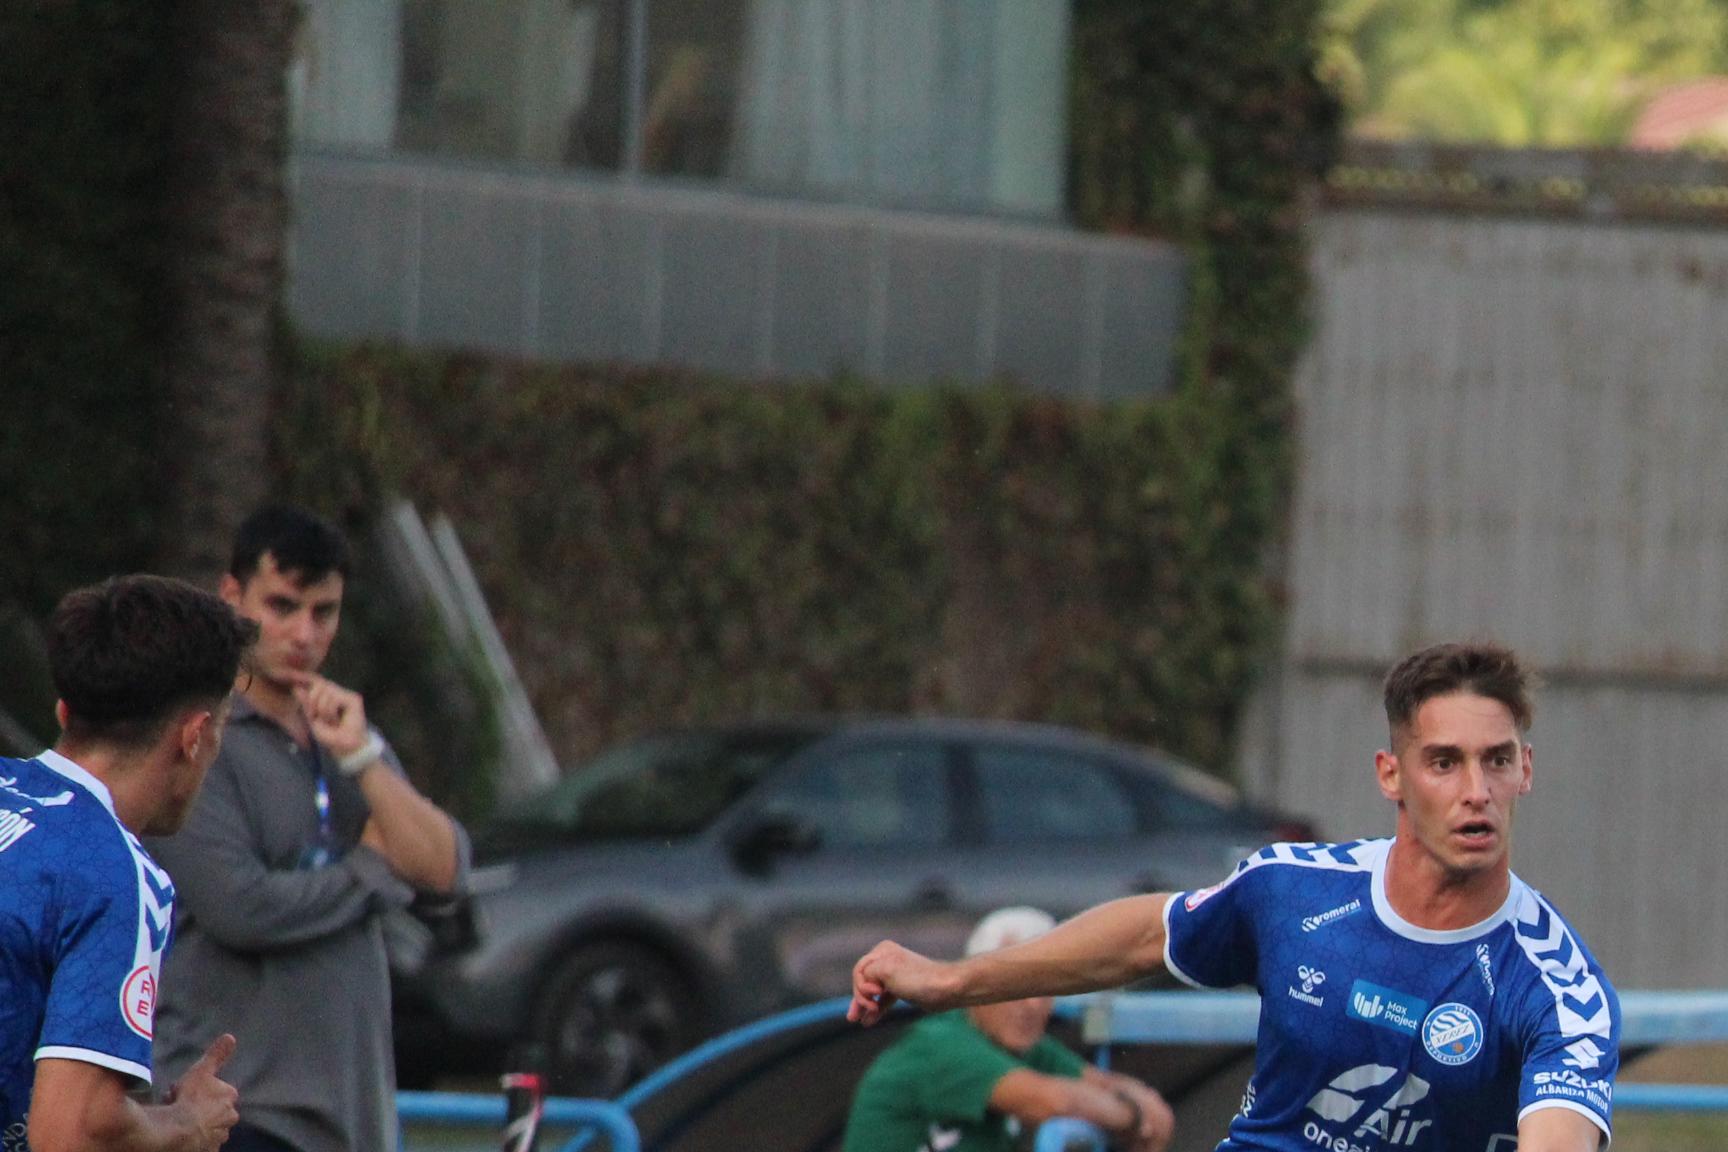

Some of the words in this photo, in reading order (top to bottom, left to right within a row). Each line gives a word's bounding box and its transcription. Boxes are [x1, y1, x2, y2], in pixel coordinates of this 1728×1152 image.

[1288, 985, 1324, 1008] hummel
[1386, 1000, 1409, 1015] Max
[1384, 1010, 1419, 1031] Project
[1535, 1083, 1585, 1097] ALBARIZA
[1353, 1108, 1433, 1146] Air
